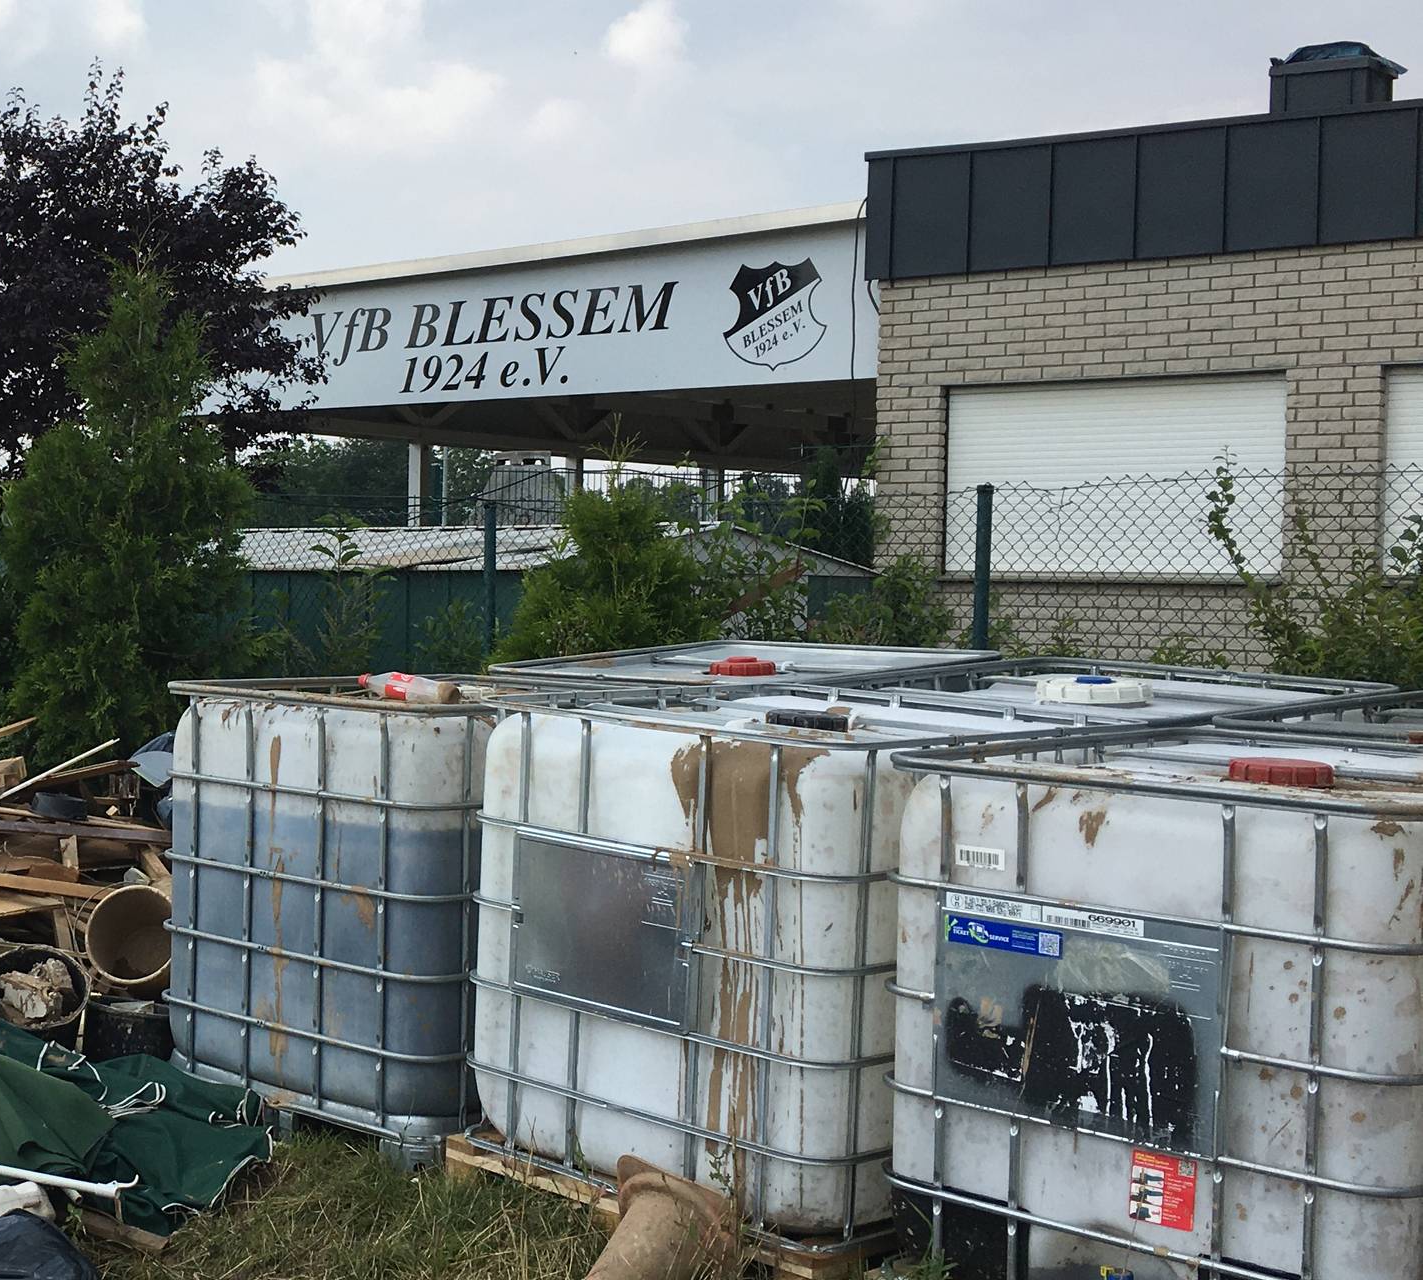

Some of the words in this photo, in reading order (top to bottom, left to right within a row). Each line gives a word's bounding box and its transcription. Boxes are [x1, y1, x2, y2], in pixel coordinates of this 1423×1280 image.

[747, 268, 792, 311] VfB
[311, 307, 392, 366] VfB
[404, 281, 679, 349] BLESSEM
[742, 300, 804, 349] BLESSEM
[754, 333, 779, 358] 1924
[398, 351, 489, 394] 1924
[500, 346, 568, 388] e.V.
[953, 928, 969, 936] TICKET
[988, 934, 1010, 943] SERVICE
[1088, 914, 1136, 928] 669901
